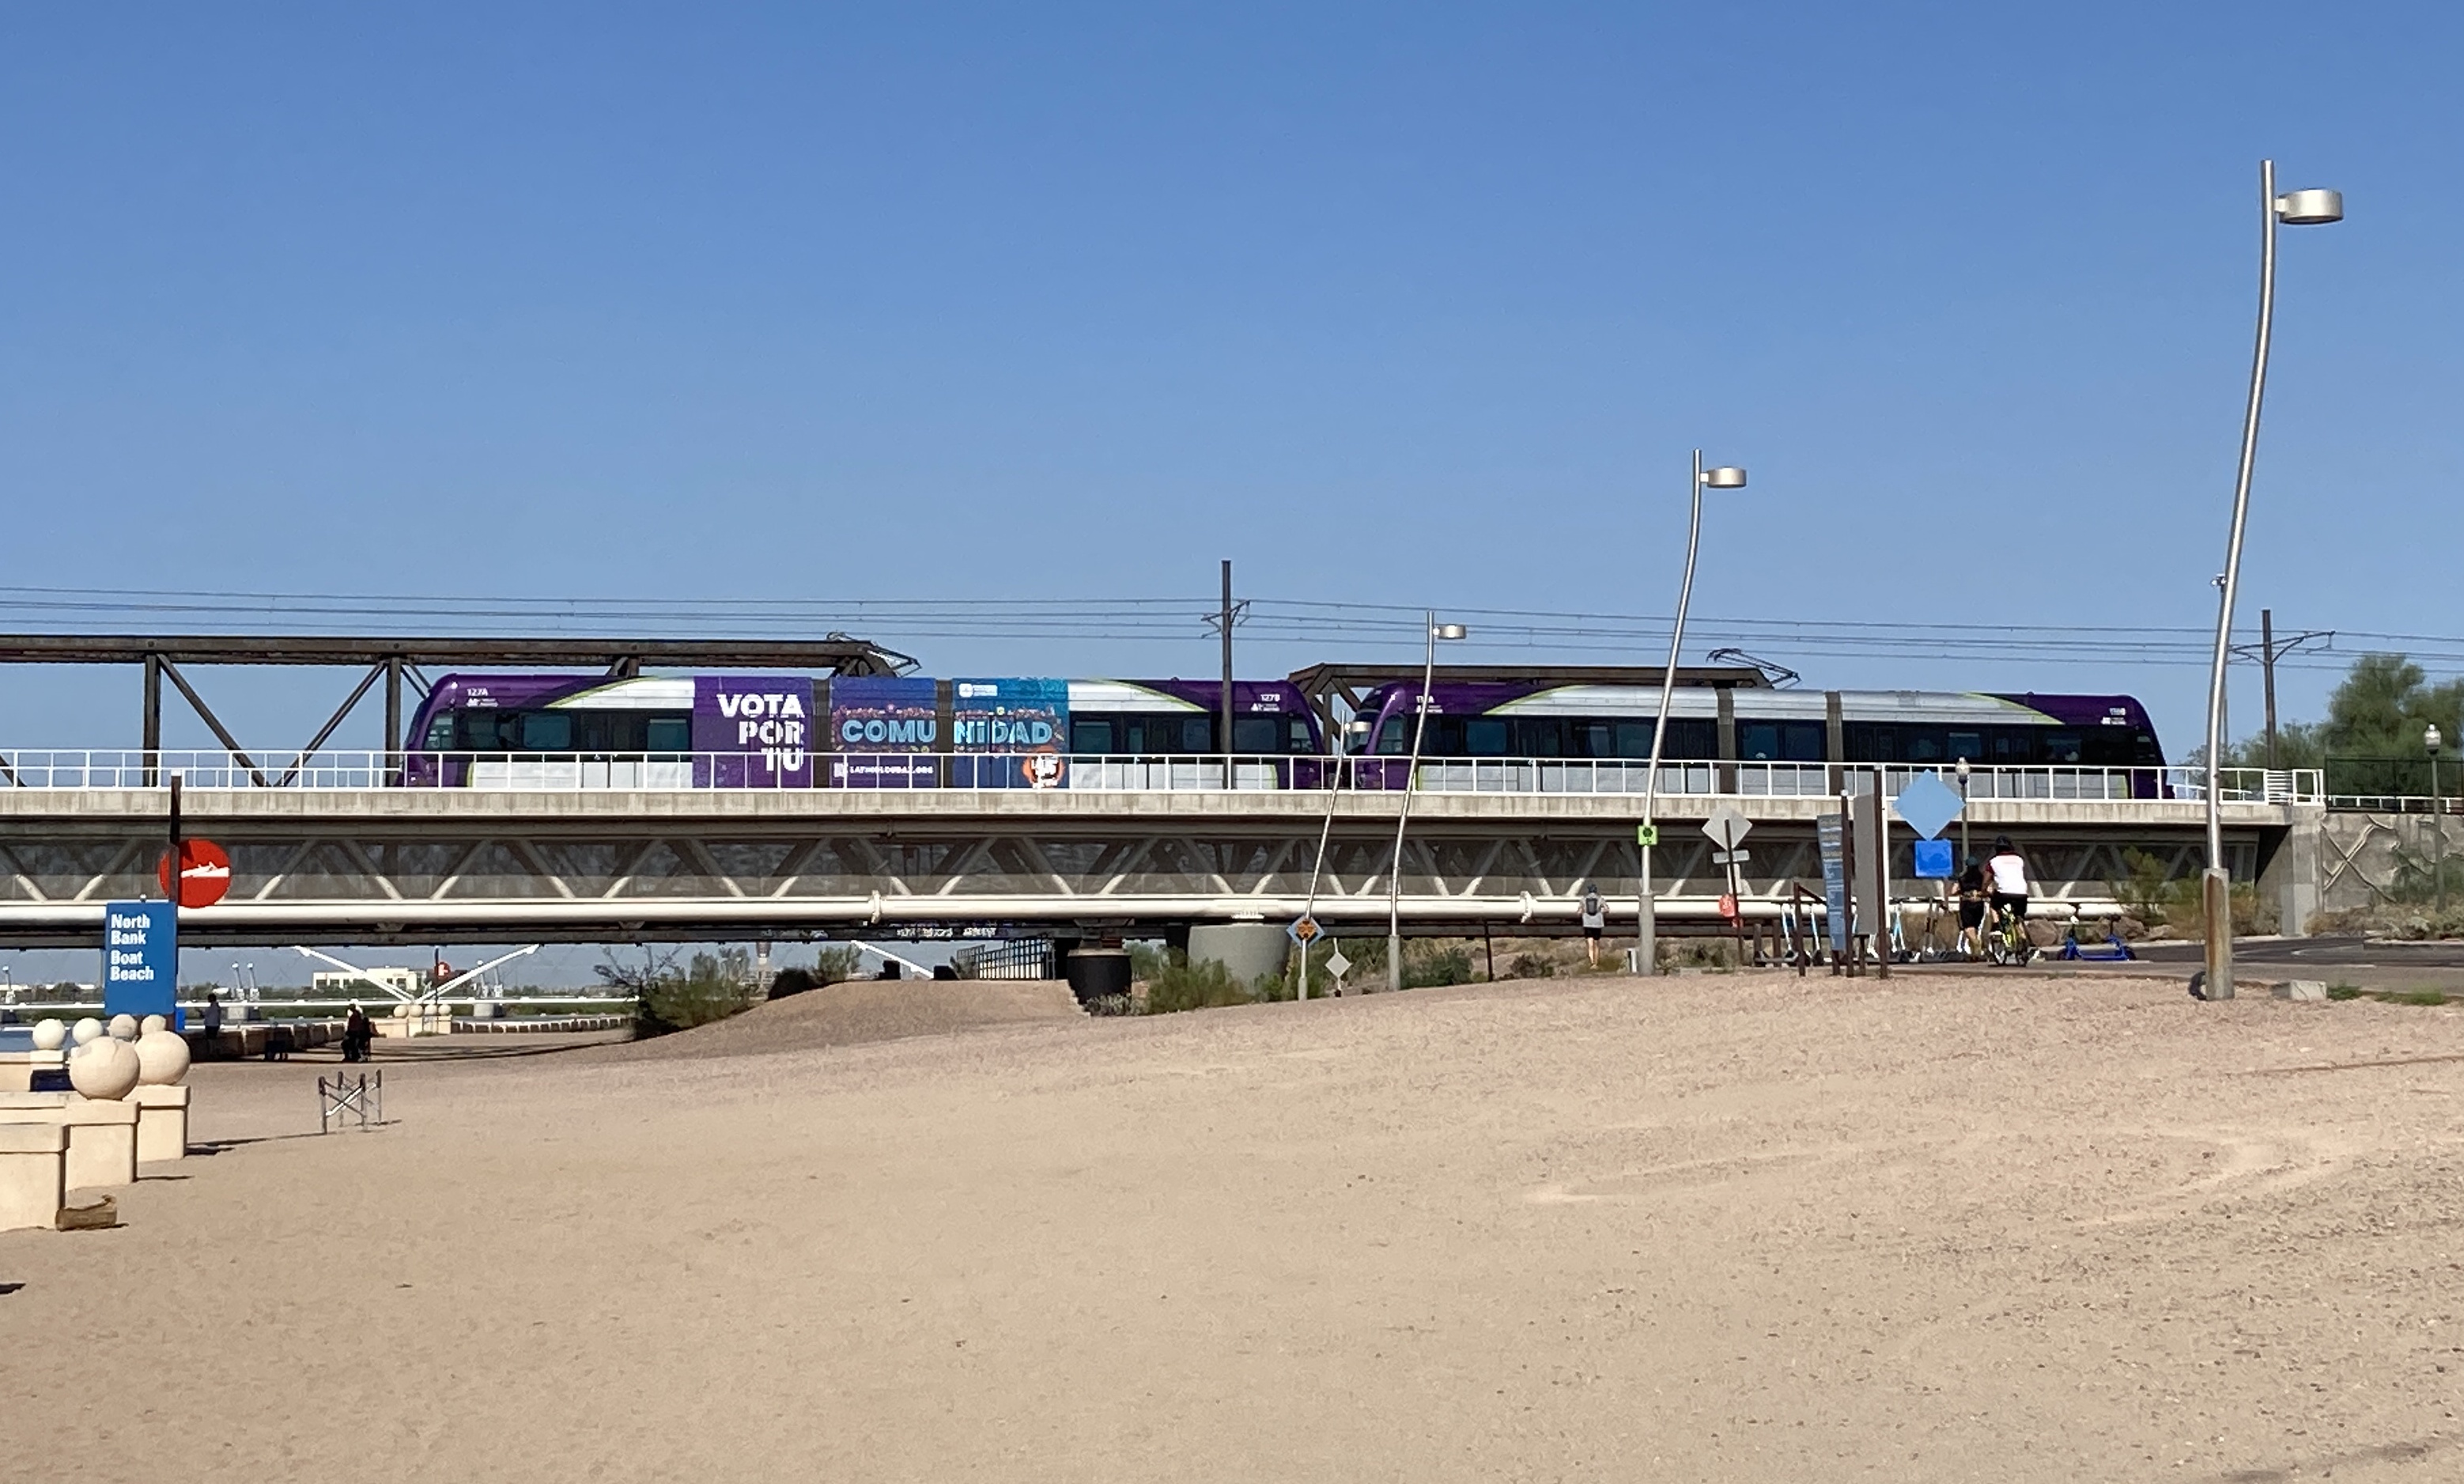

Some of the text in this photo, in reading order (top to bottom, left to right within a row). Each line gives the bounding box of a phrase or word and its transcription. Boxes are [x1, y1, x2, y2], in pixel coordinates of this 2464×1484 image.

[716, 693, 805, 718] VOTA
[739, 720, 805, 745] POR
[761, 747, 804, 772] TU
[111, 913, 150, 928] North
[111, 929, 147, 945] Bank
[110, 950, 144, 965] Boat
[110, 965, 154, 981] Beach
